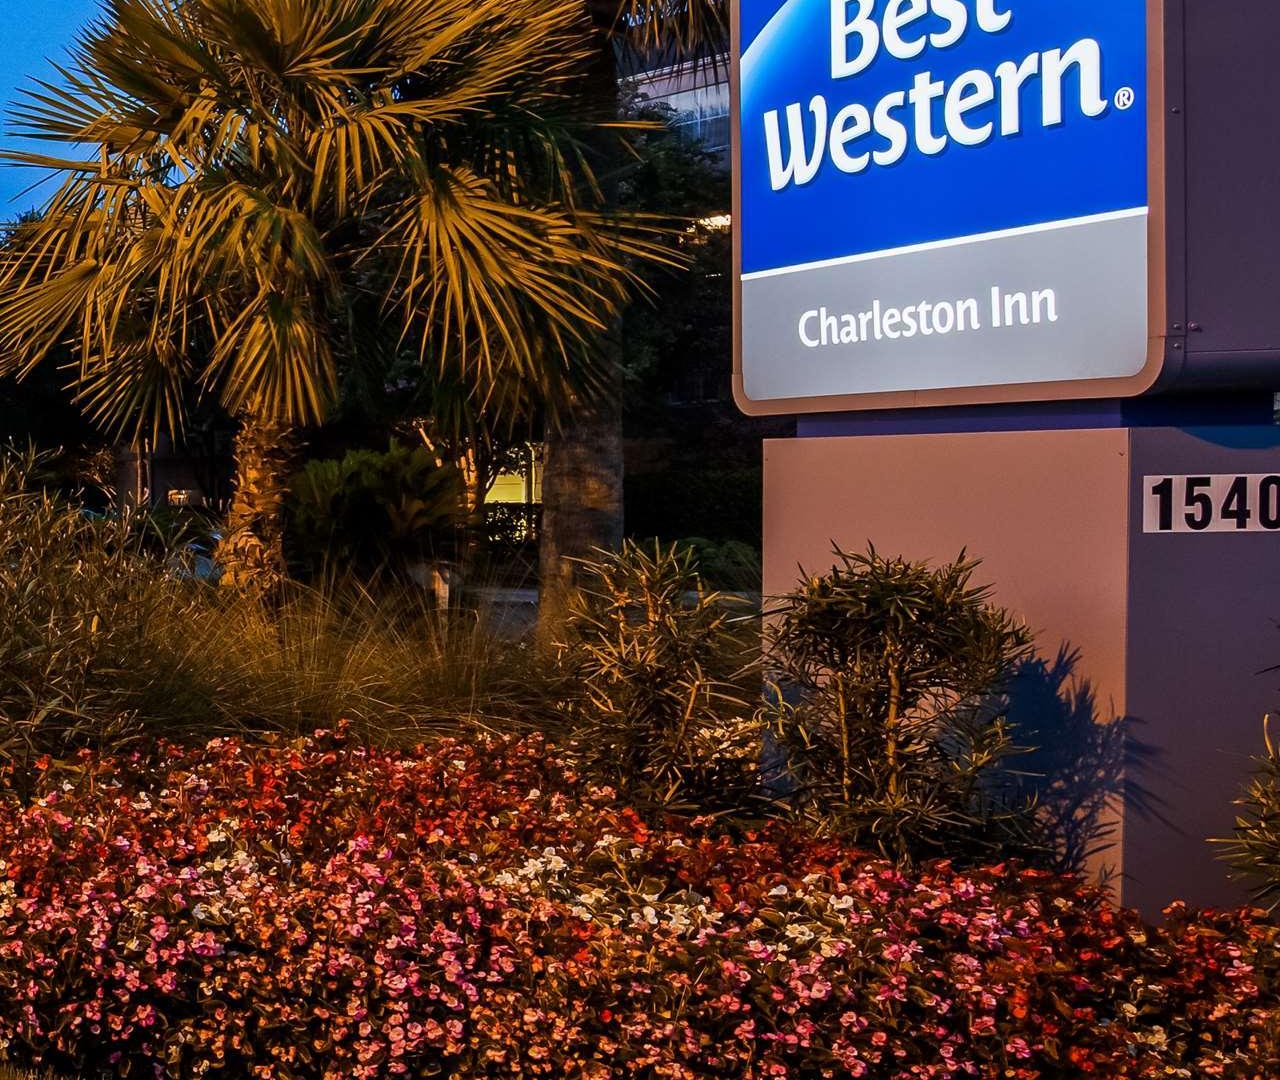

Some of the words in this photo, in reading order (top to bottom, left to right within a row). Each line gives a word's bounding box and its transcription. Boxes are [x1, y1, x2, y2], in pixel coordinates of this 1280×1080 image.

[798, 299, 980, 348] Charleston
[991, 286, 1058, 328] Inn
[1151, 475, 1280, 531] 1540
